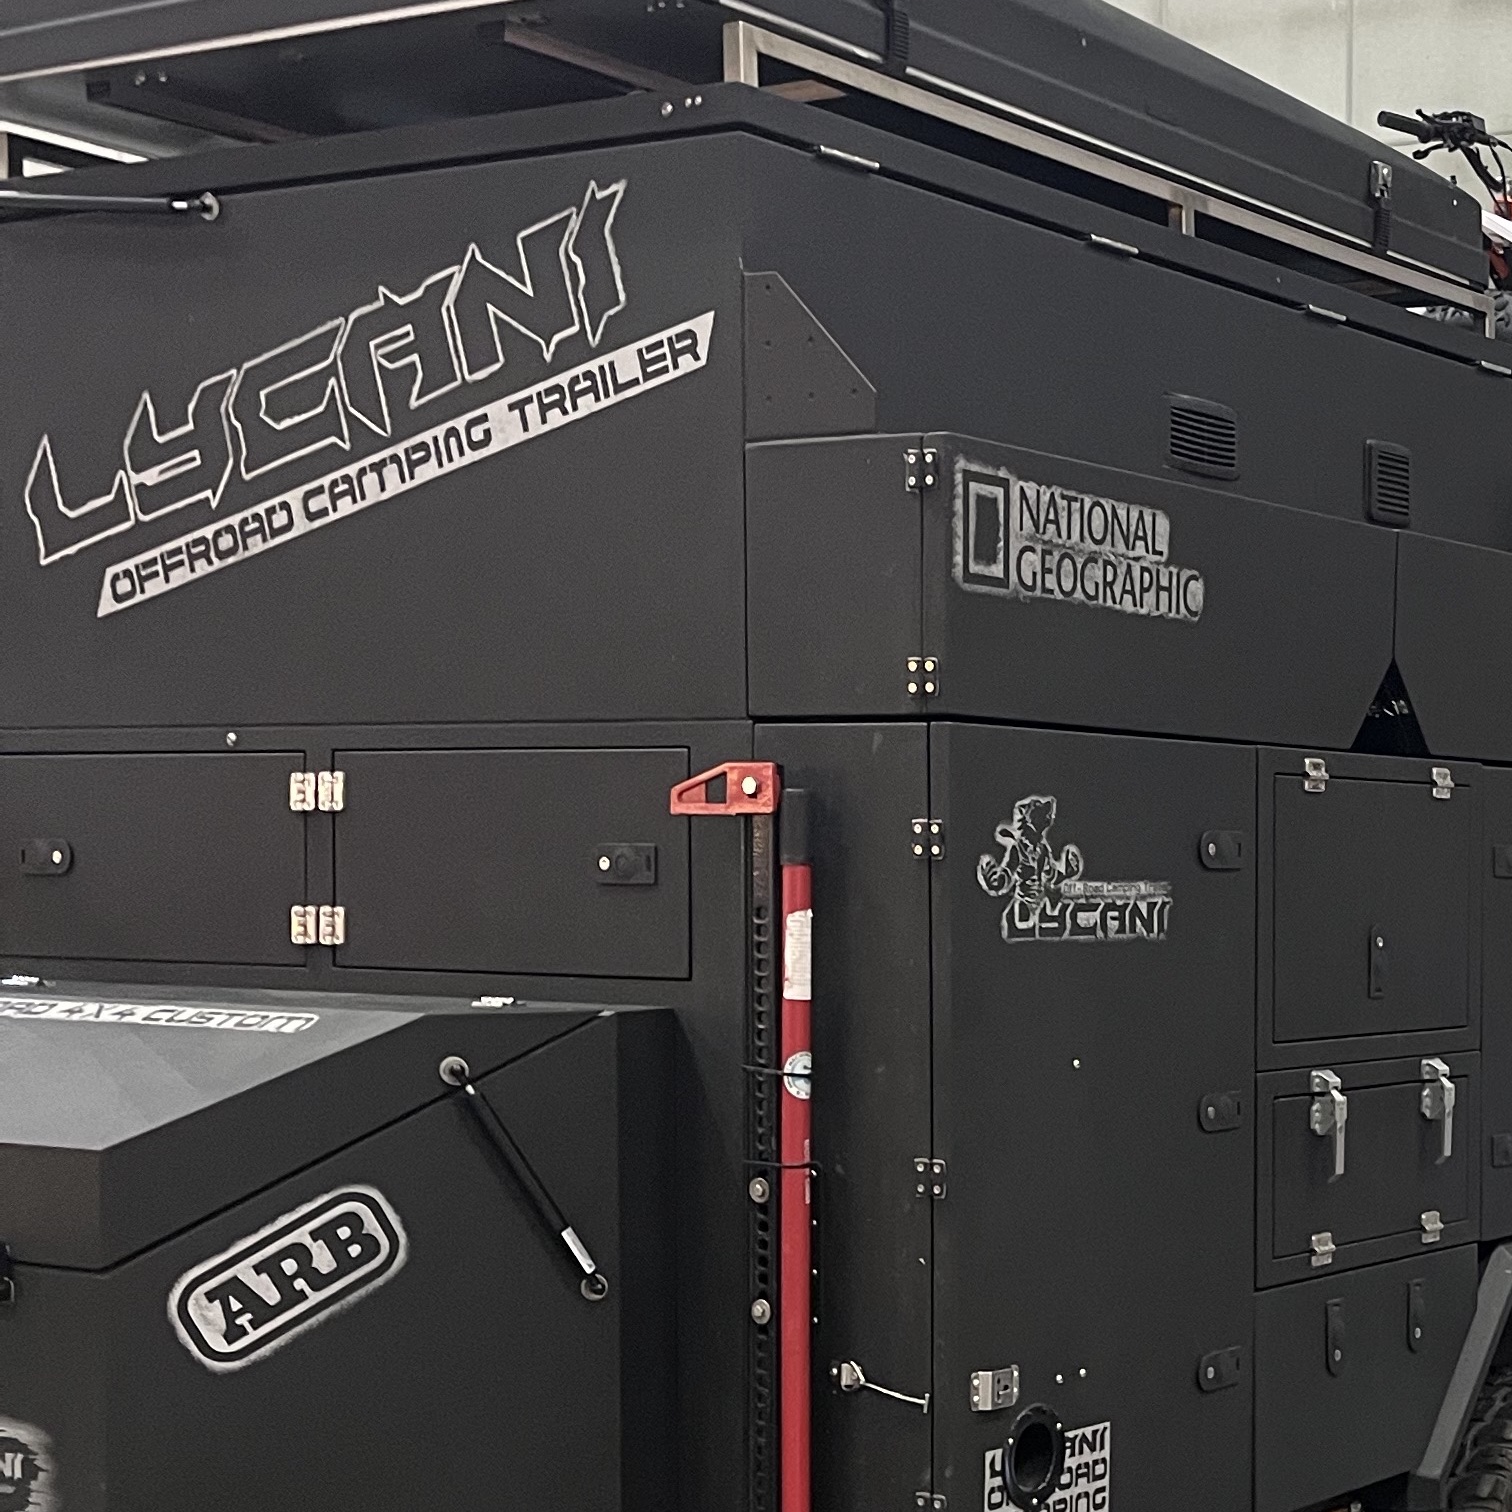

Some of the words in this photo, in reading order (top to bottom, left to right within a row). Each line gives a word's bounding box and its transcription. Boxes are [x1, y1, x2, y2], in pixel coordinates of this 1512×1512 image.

[25, 178, 628, 566] LYCANI
[110, 500, 294, 604] OFFROAD
[303, 413, 493, 523] CAMPING
[508, 331, 703, 433] TRAILER
[1019, 485, 1164, 556] NATIONAL
[1016, 545, 1200, 617] GEOGRAPHIC
[59, 1002, 139, 1021] 4X4
[141, 1008, 315, 1031] CUSTOM
[204, 1211, 382, 1346] ARB
[987, 1456, 1108, 1512] OOAD
